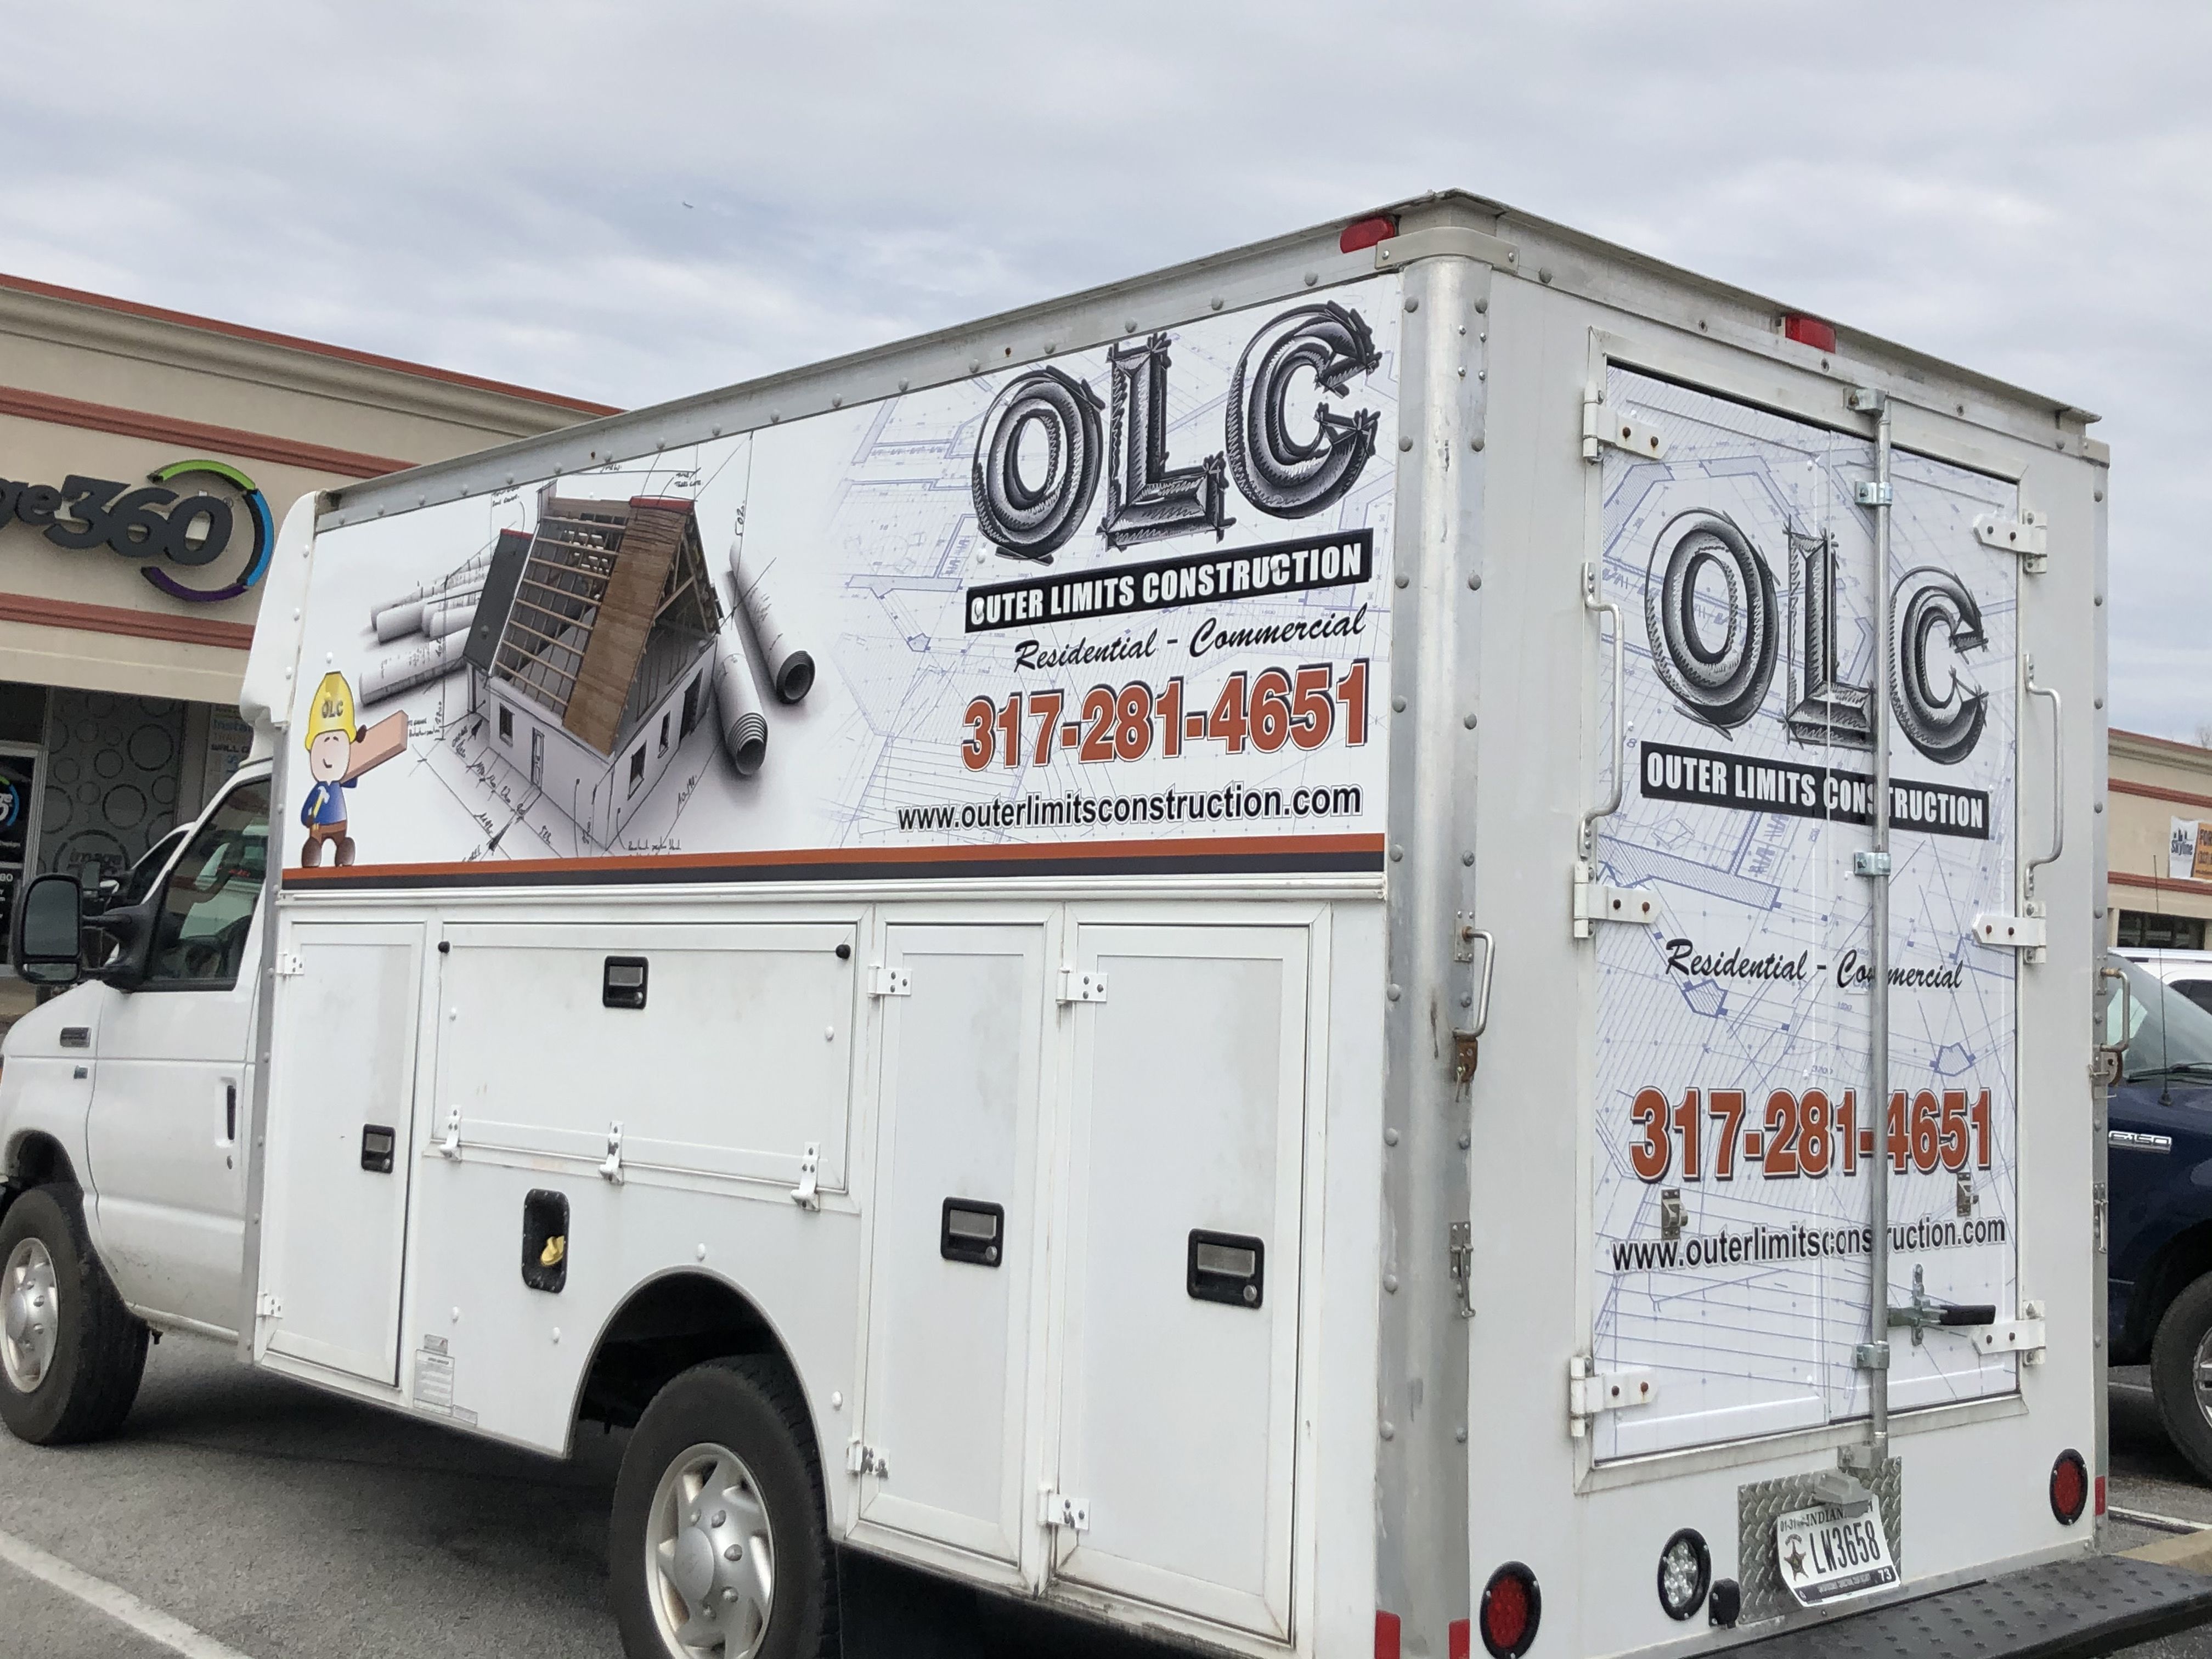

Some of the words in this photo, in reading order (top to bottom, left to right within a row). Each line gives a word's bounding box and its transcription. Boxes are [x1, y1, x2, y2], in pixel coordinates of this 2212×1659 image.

[972, 300, 1381, 565] OLC
[971, 589, 1043, 625] OUTER
[1051, 575, 1134, 615] LIMITS
[1143, 543, 1362, 603] CONSTRUCTION
[1013, 627, 1158, 673] Residential
[1189, 602, 1368, 657] Commercial
[1644, 506, 1990, 766] OLC
[321, 699, 343, 718] OLC
[961, 658, 1369, 772] 317-281-4651
[1647, 752, 1727, 795] OUTER
[1735, 764, 1816, 806] LIMITS
[898, 783, 1361, 831] www.outerlimitsconstruction.com
[1666, 938, 1807, 980] Residential
[1629, 1086, 1991, 1183] 317-281-4651
[1613, 1217, 2005, 1271] www.outerlimitsconsuction.com
[1806, 1508, 1847, 1527] INDIAN
[1877, 1568, 1892, 1582] 73
